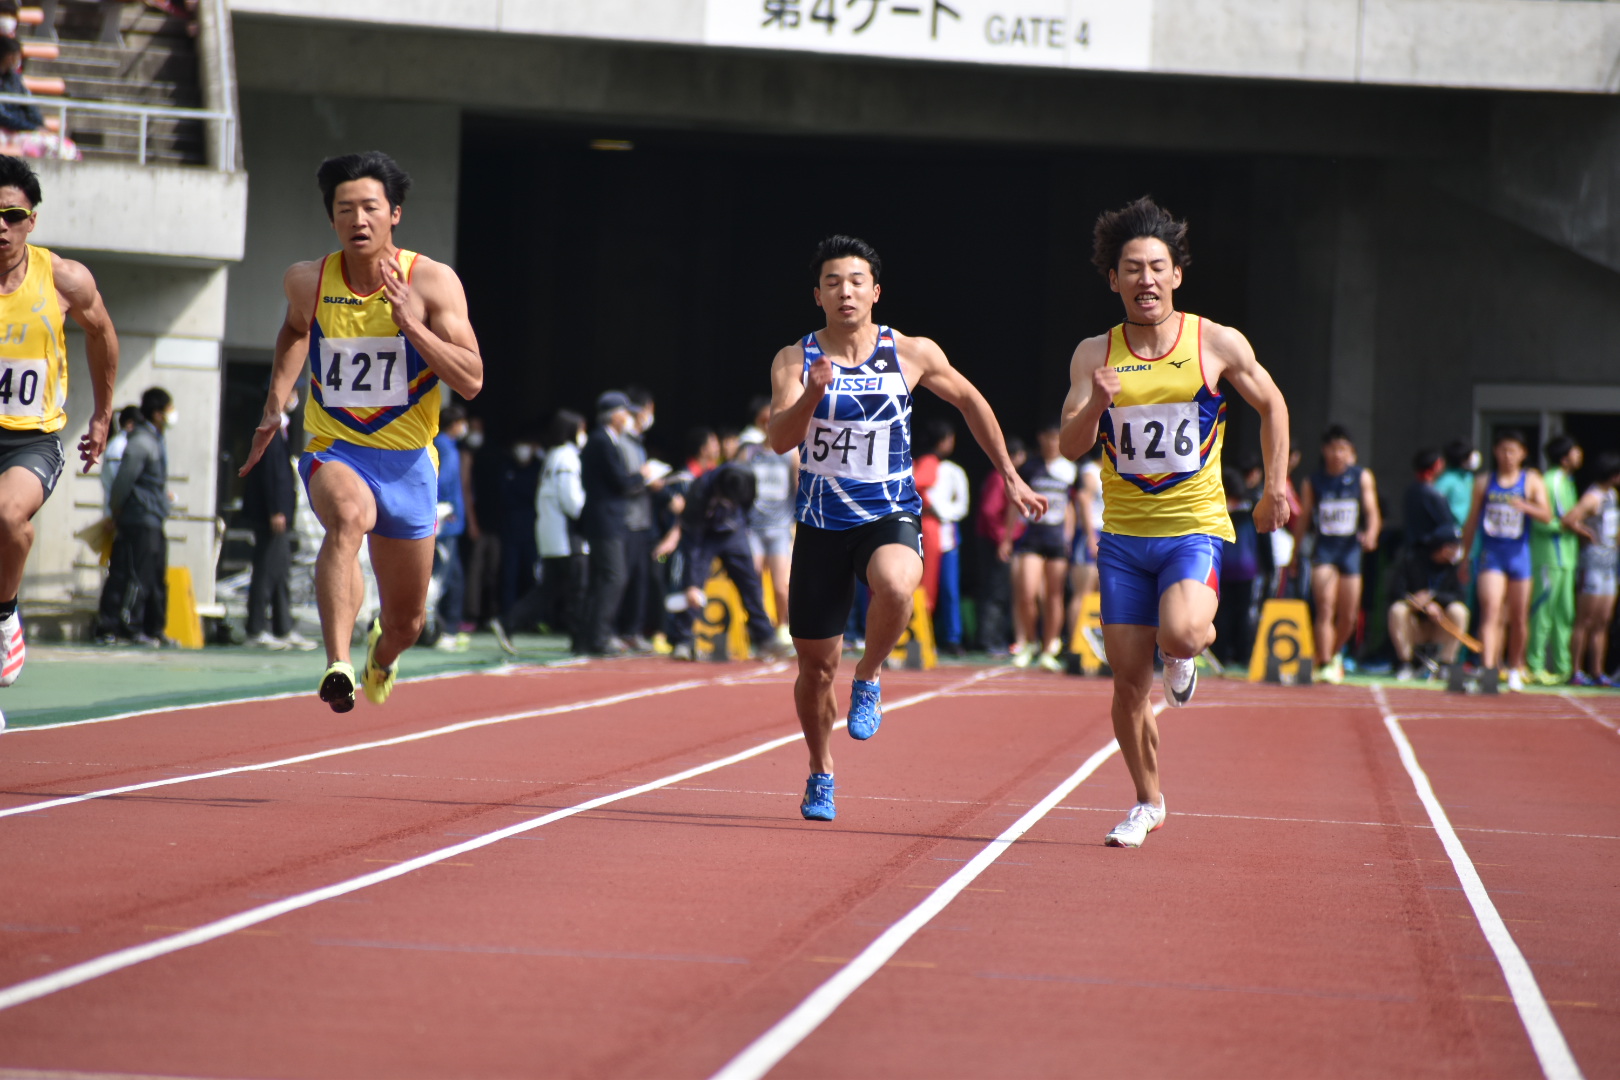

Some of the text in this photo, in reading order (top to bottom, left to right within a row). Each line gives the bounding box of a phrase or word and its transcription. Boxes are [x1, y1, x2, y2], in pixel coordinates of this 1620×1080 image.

[984, 14, 1091, 51] GATE 4
[323, 296, 363, 305] SUZUKI
[326, 351, 397, 391] 427
[1114, 364, 1152, 373] UZUKI
[812, 426, 877, 466] 541
[1120, 418, 1194, 461] 426
[1268, 618, 1300, 663] 6
